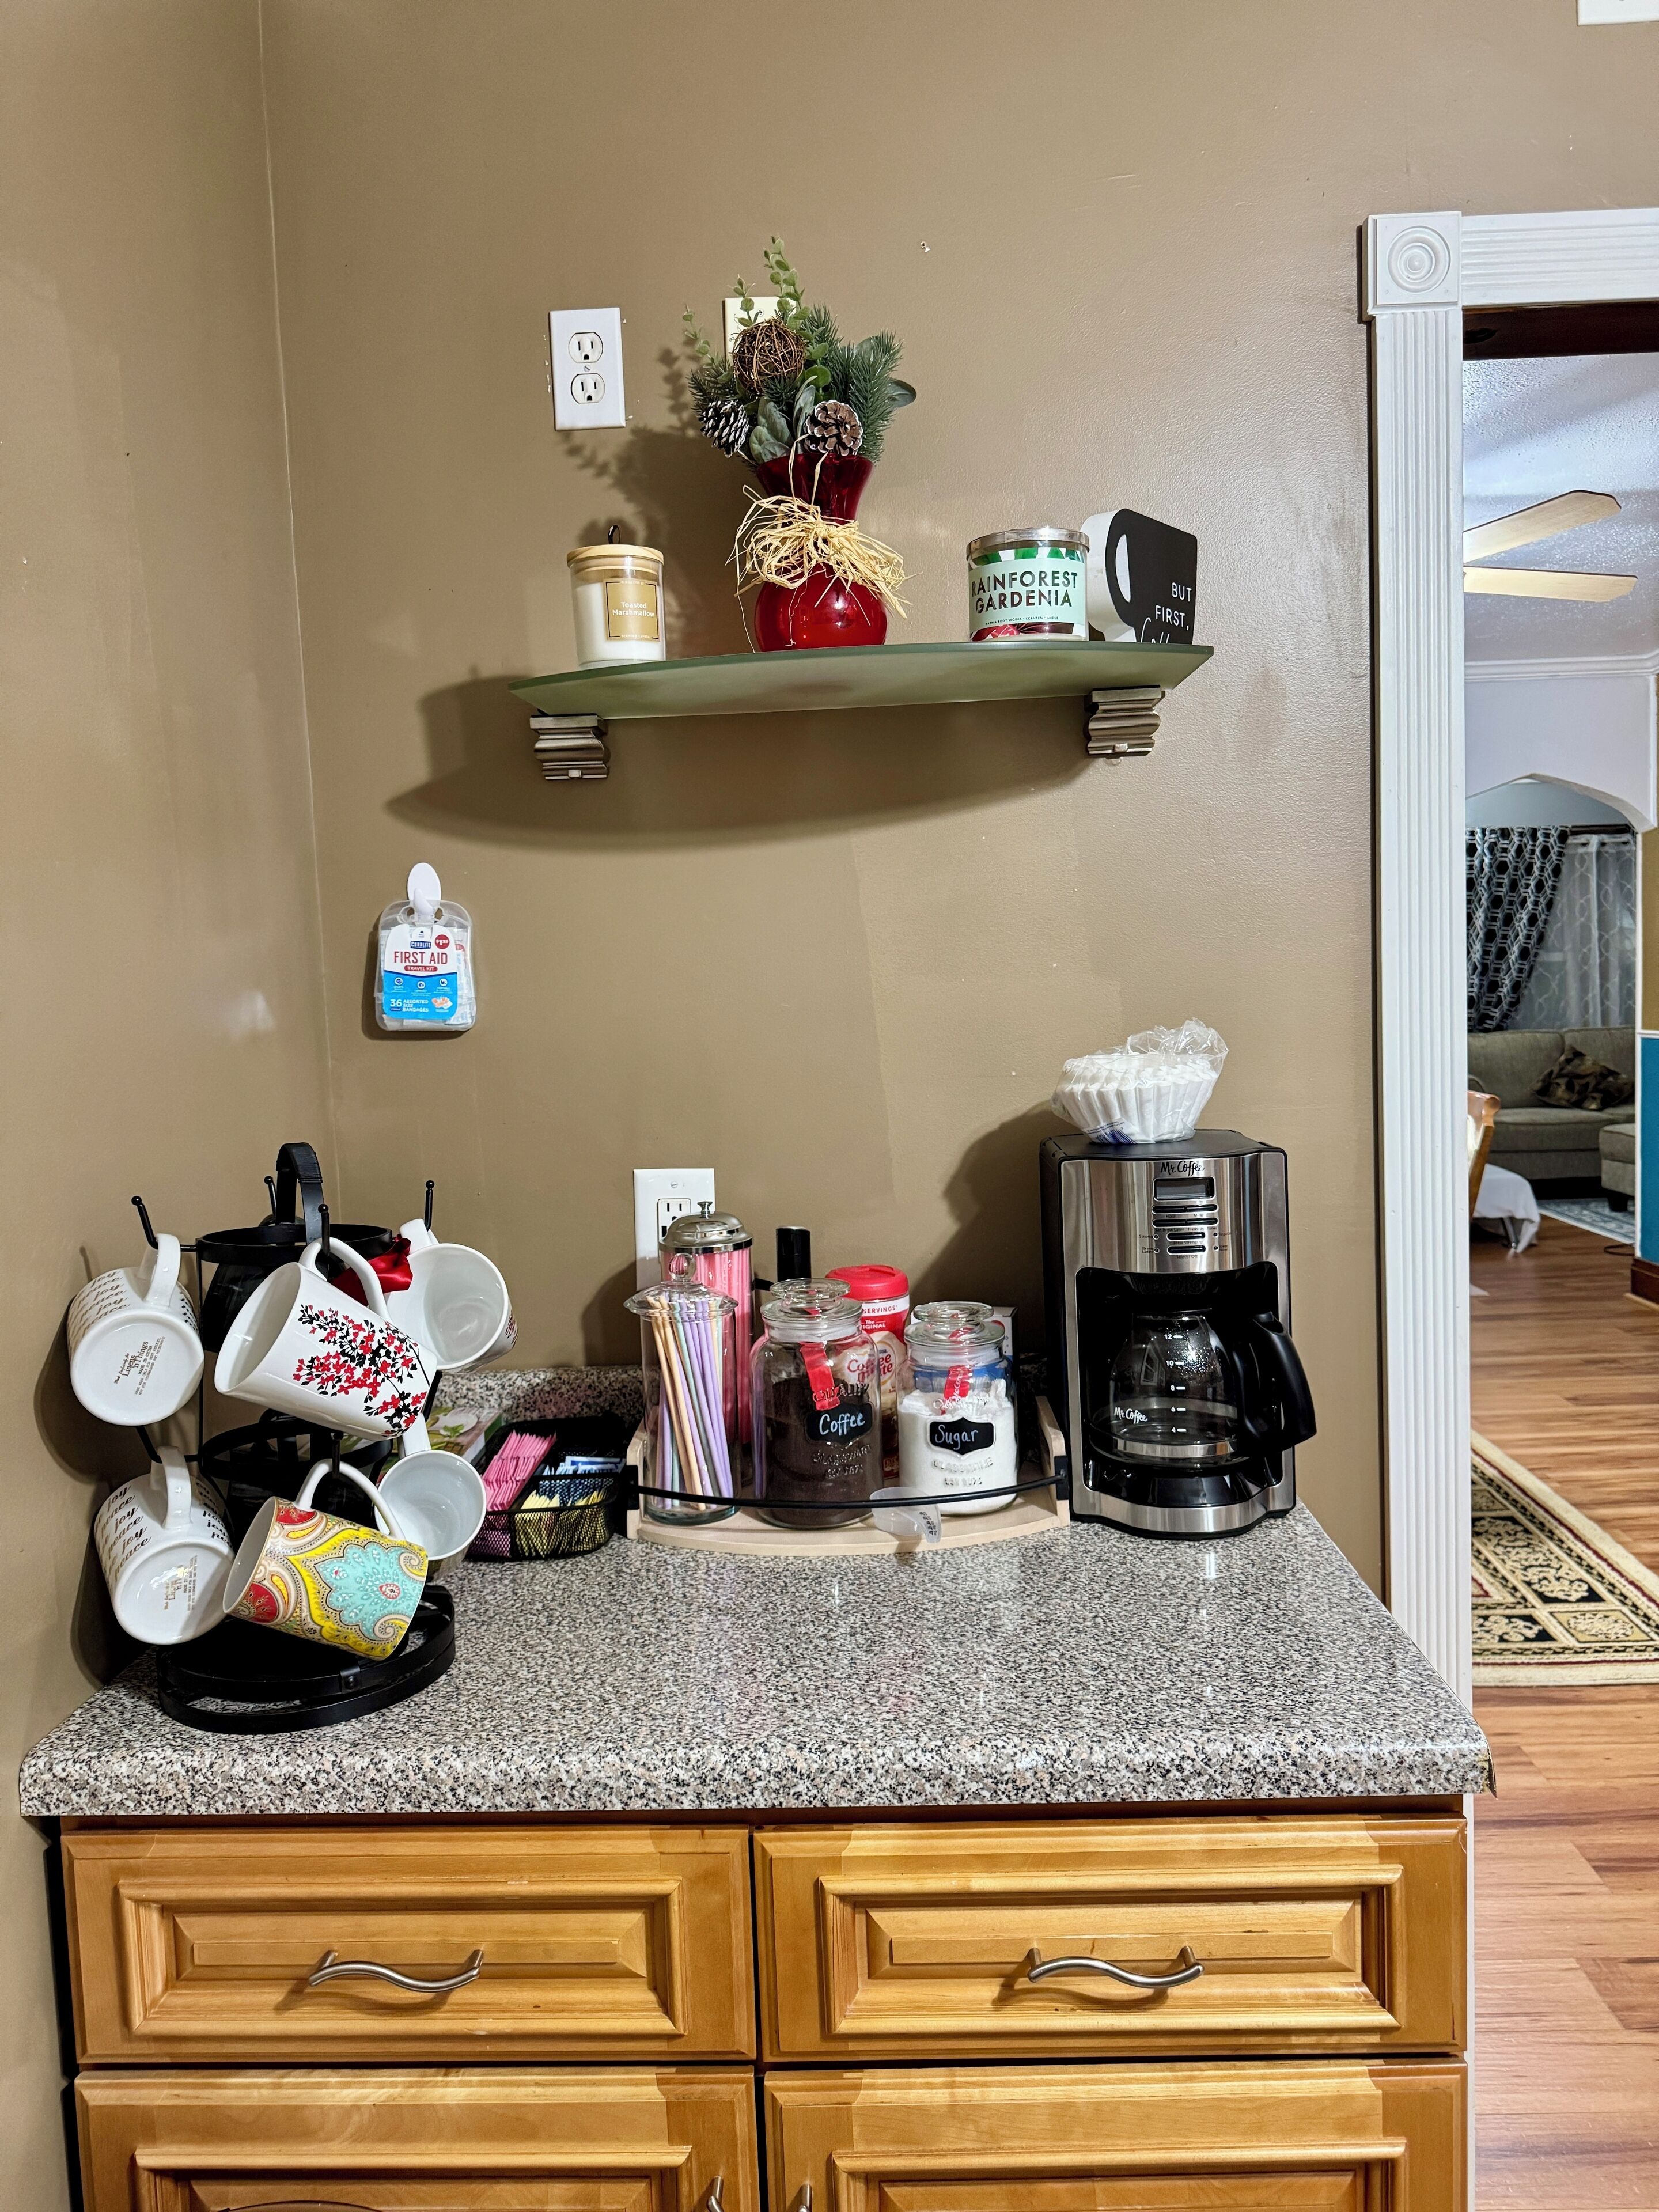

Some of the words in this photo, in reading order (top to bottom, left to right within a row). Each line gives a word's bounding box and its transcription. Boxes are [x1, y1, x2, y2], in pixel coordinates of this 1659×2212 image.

[972, 570, 1078, 597] RAINFOREST
[1172, 582, 1192, 602] BUT
[975, 589, 1072, 613] GARDENIA
[612, 609, 654, 618] Marshmallow
[1156, 605, 1189, 631] FIRST,
[394, 951, 426, 964] FIRST
[429, 952, 448, 964] AID
[390, 999, 402, 1007] 36
[1160, 1161, 1176, 1175] Mr.
[1177, 1161, 1205, 1176] Coffee
[93, 1284, 124, 1301] joy
[96, 1297, 128, 1316] joy
[122, 1354, 136, 1377] Linens
[819, 1412, 865, 1436] Coffee
[1125, 1408, 1148, 1424] Coffee
[935, 1424, 978, 1450] Sugar
[107, 1486, 131, 1512] joy
[101, 1495, 135, 1539] peace
[115, 1506, 139, 1533] joy
[108, 1516, 144, 1560] peace
[122, 1527, 147, 1554] joy
[115, 1537, 151, 1583] peace
